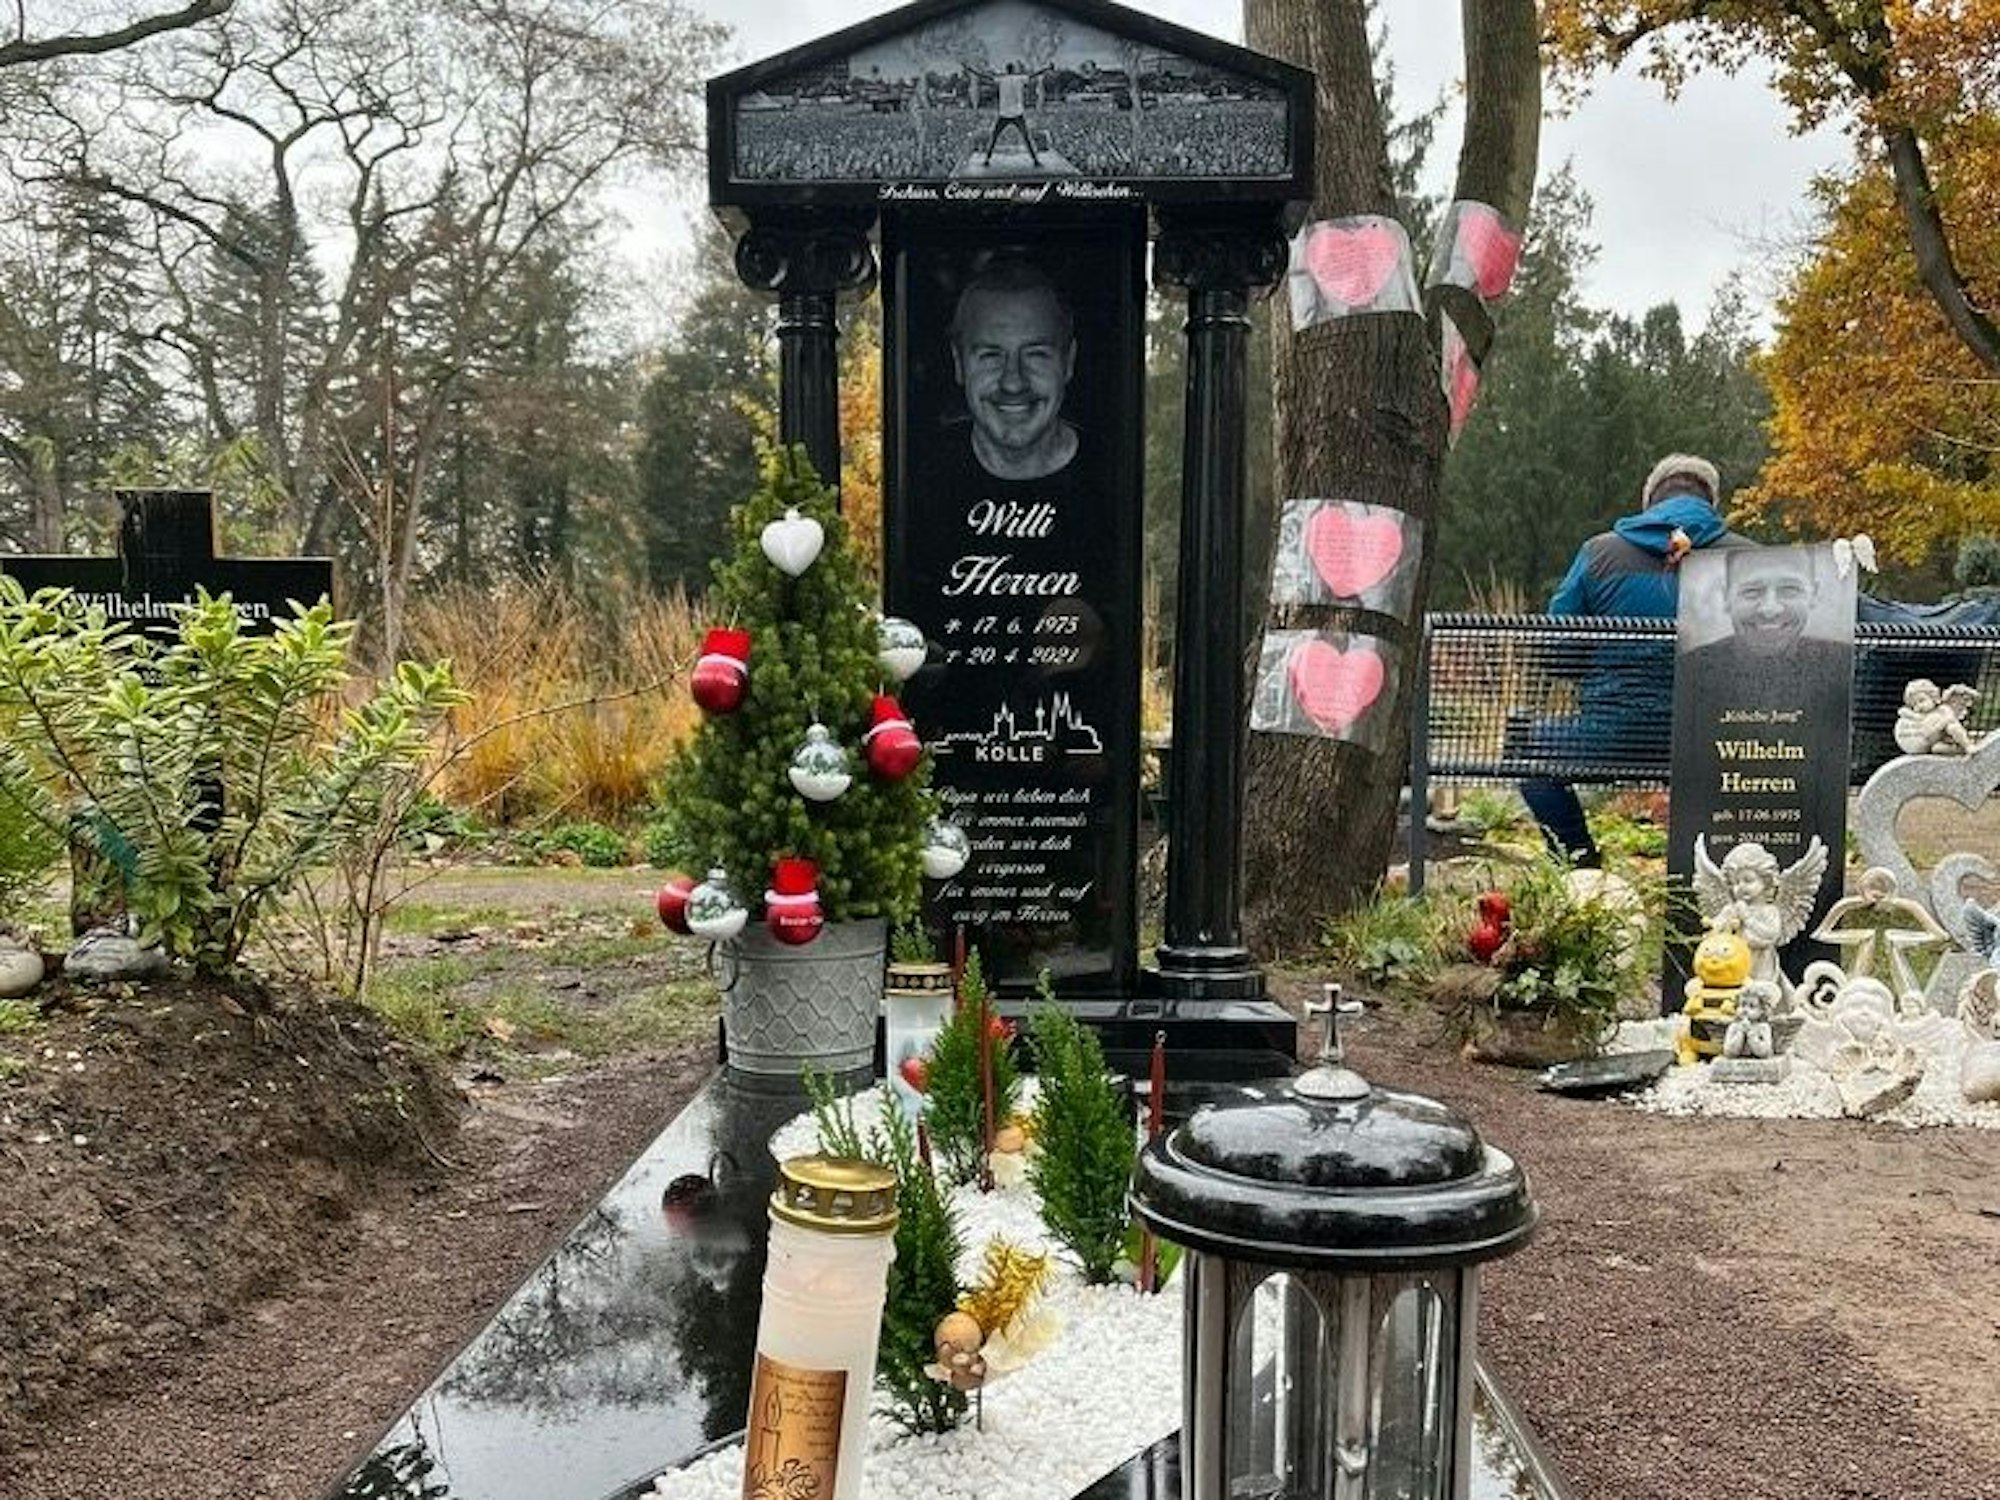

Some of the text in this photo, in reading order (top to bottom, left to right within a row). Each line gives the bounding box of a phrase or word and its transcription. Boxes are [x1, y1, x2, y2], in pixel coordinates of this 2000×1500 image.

[983, 183, 1017, 200] und
[1020, 181, 1050, 204] auf
[967, 499, 1056, 538] Willi
[941, 553, 1082, 596] Herren
[1033, 615, 1080, 634] 1975
[1028, 645, 1080, 665] 2021
[975, 741, 1044, 762] KÖLLE
[1715, 740, 1805, 759] Wilhelm
[1720, 772, 1798, 793] Herren
[1059, 788, 1090, 804] dich
[1039, 834, 1072, 851] dich
[1020, 881, 1056, 898] und
[1058, 880, 1094, 902] auf
